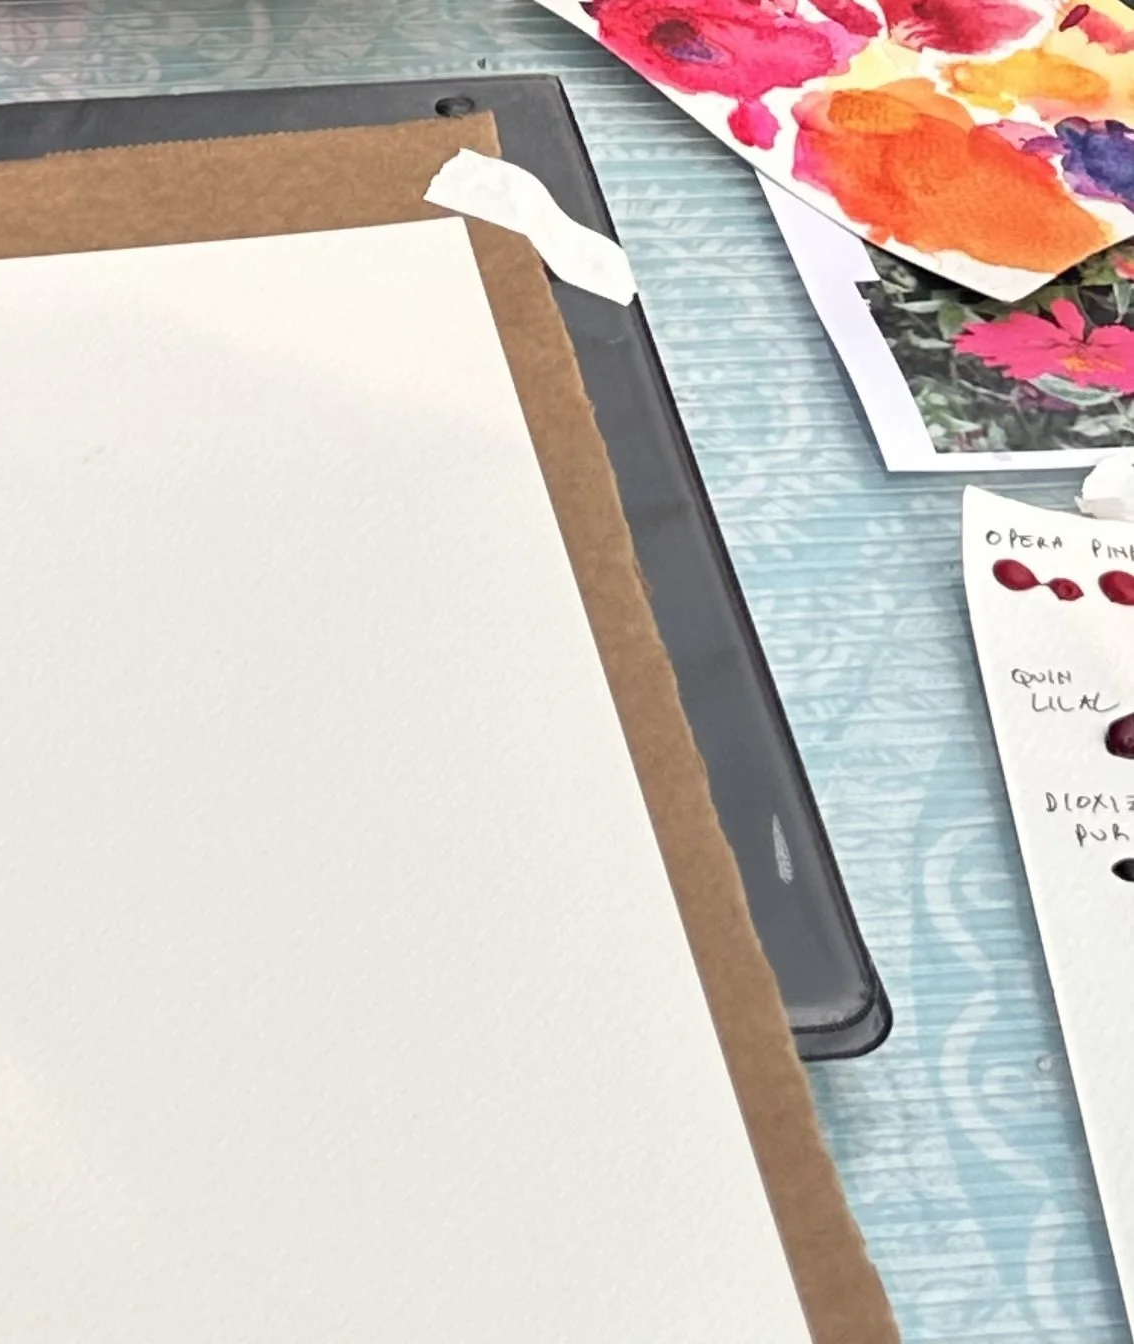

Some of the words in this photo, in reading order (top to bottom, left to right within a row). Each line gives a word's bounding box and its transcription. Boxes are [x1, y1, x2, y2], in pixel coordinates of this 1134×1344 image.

[985, 527, 1063, 549] OPERA
[1011, 668, 1072, 689] QUIN
[1075, 823, 1130, 848] PUR
